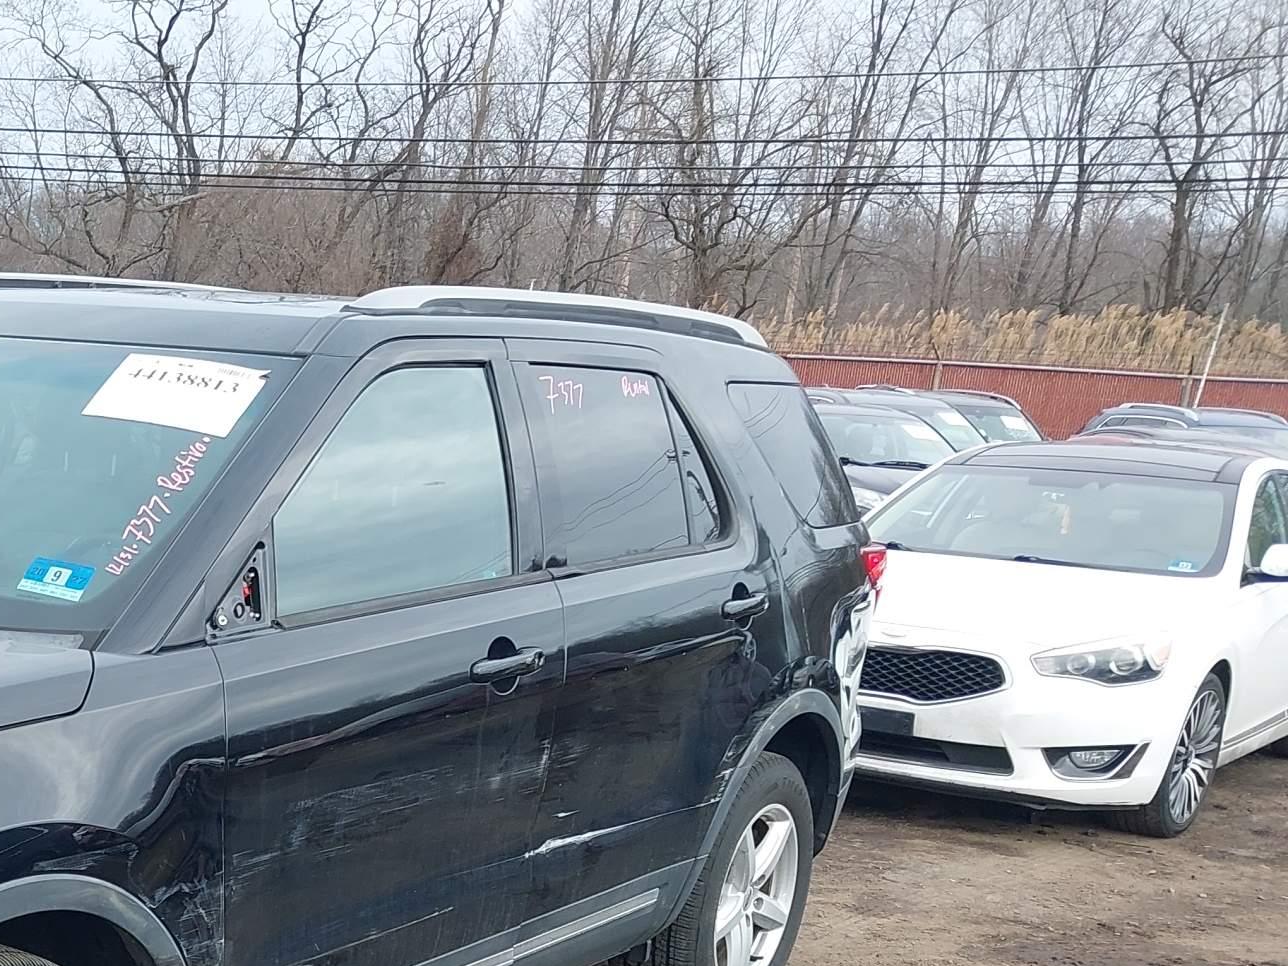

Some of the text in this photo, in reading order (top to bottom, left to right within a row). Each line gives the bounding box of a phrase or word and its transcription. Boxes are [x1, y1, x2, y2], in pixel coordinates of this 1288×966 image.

[128, 367, 240, 393] 44138813
[539, 375, 583, 416] 7377
[50, 570, 63, 582] 9
